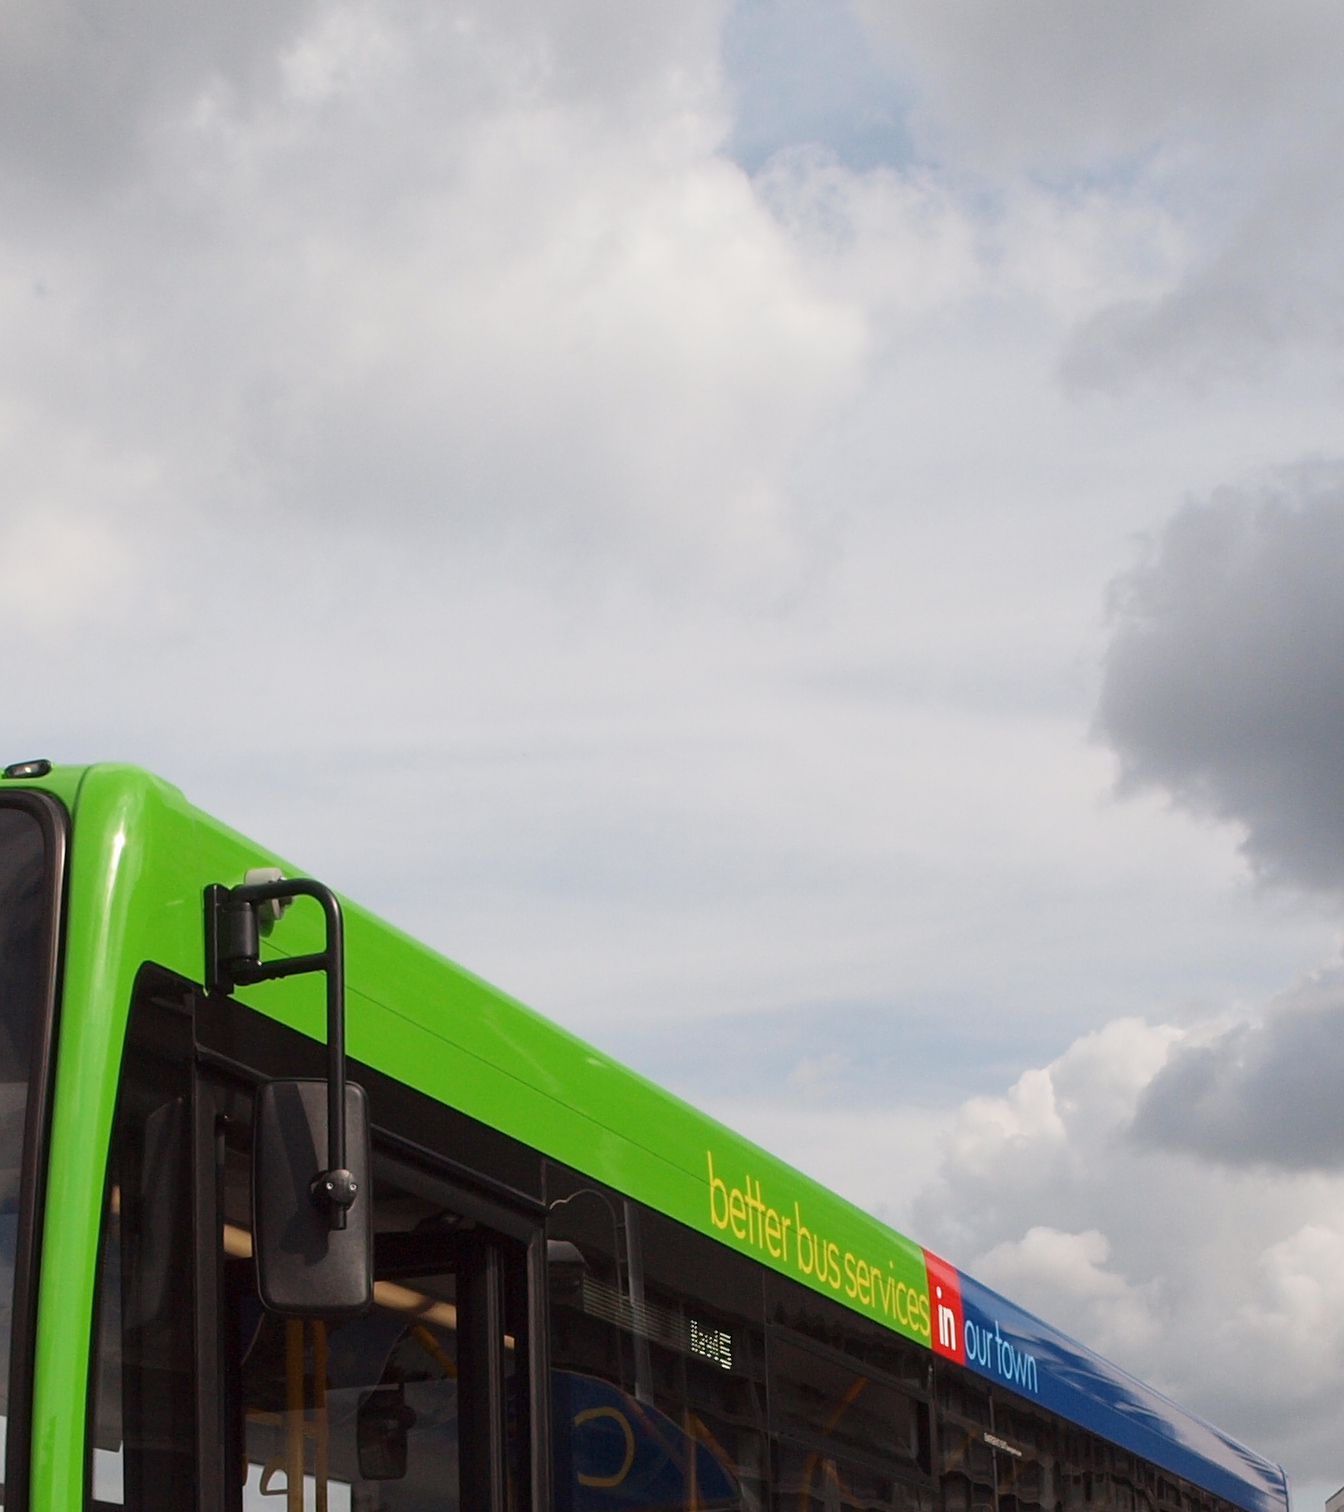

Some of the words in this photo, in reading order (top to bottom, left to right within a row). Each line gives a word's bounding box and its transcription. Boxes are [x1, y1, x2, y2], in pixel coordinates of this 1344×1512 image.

[707, 1150, 791, 1262] better
[794, 1201, 842, 1290] bus
[843, 1251, 931, 1337] services
[936, 1286, 957, 1351] in
[964, 1318, 993, 1368] our
[994, 1320, 1038, 1394] town
